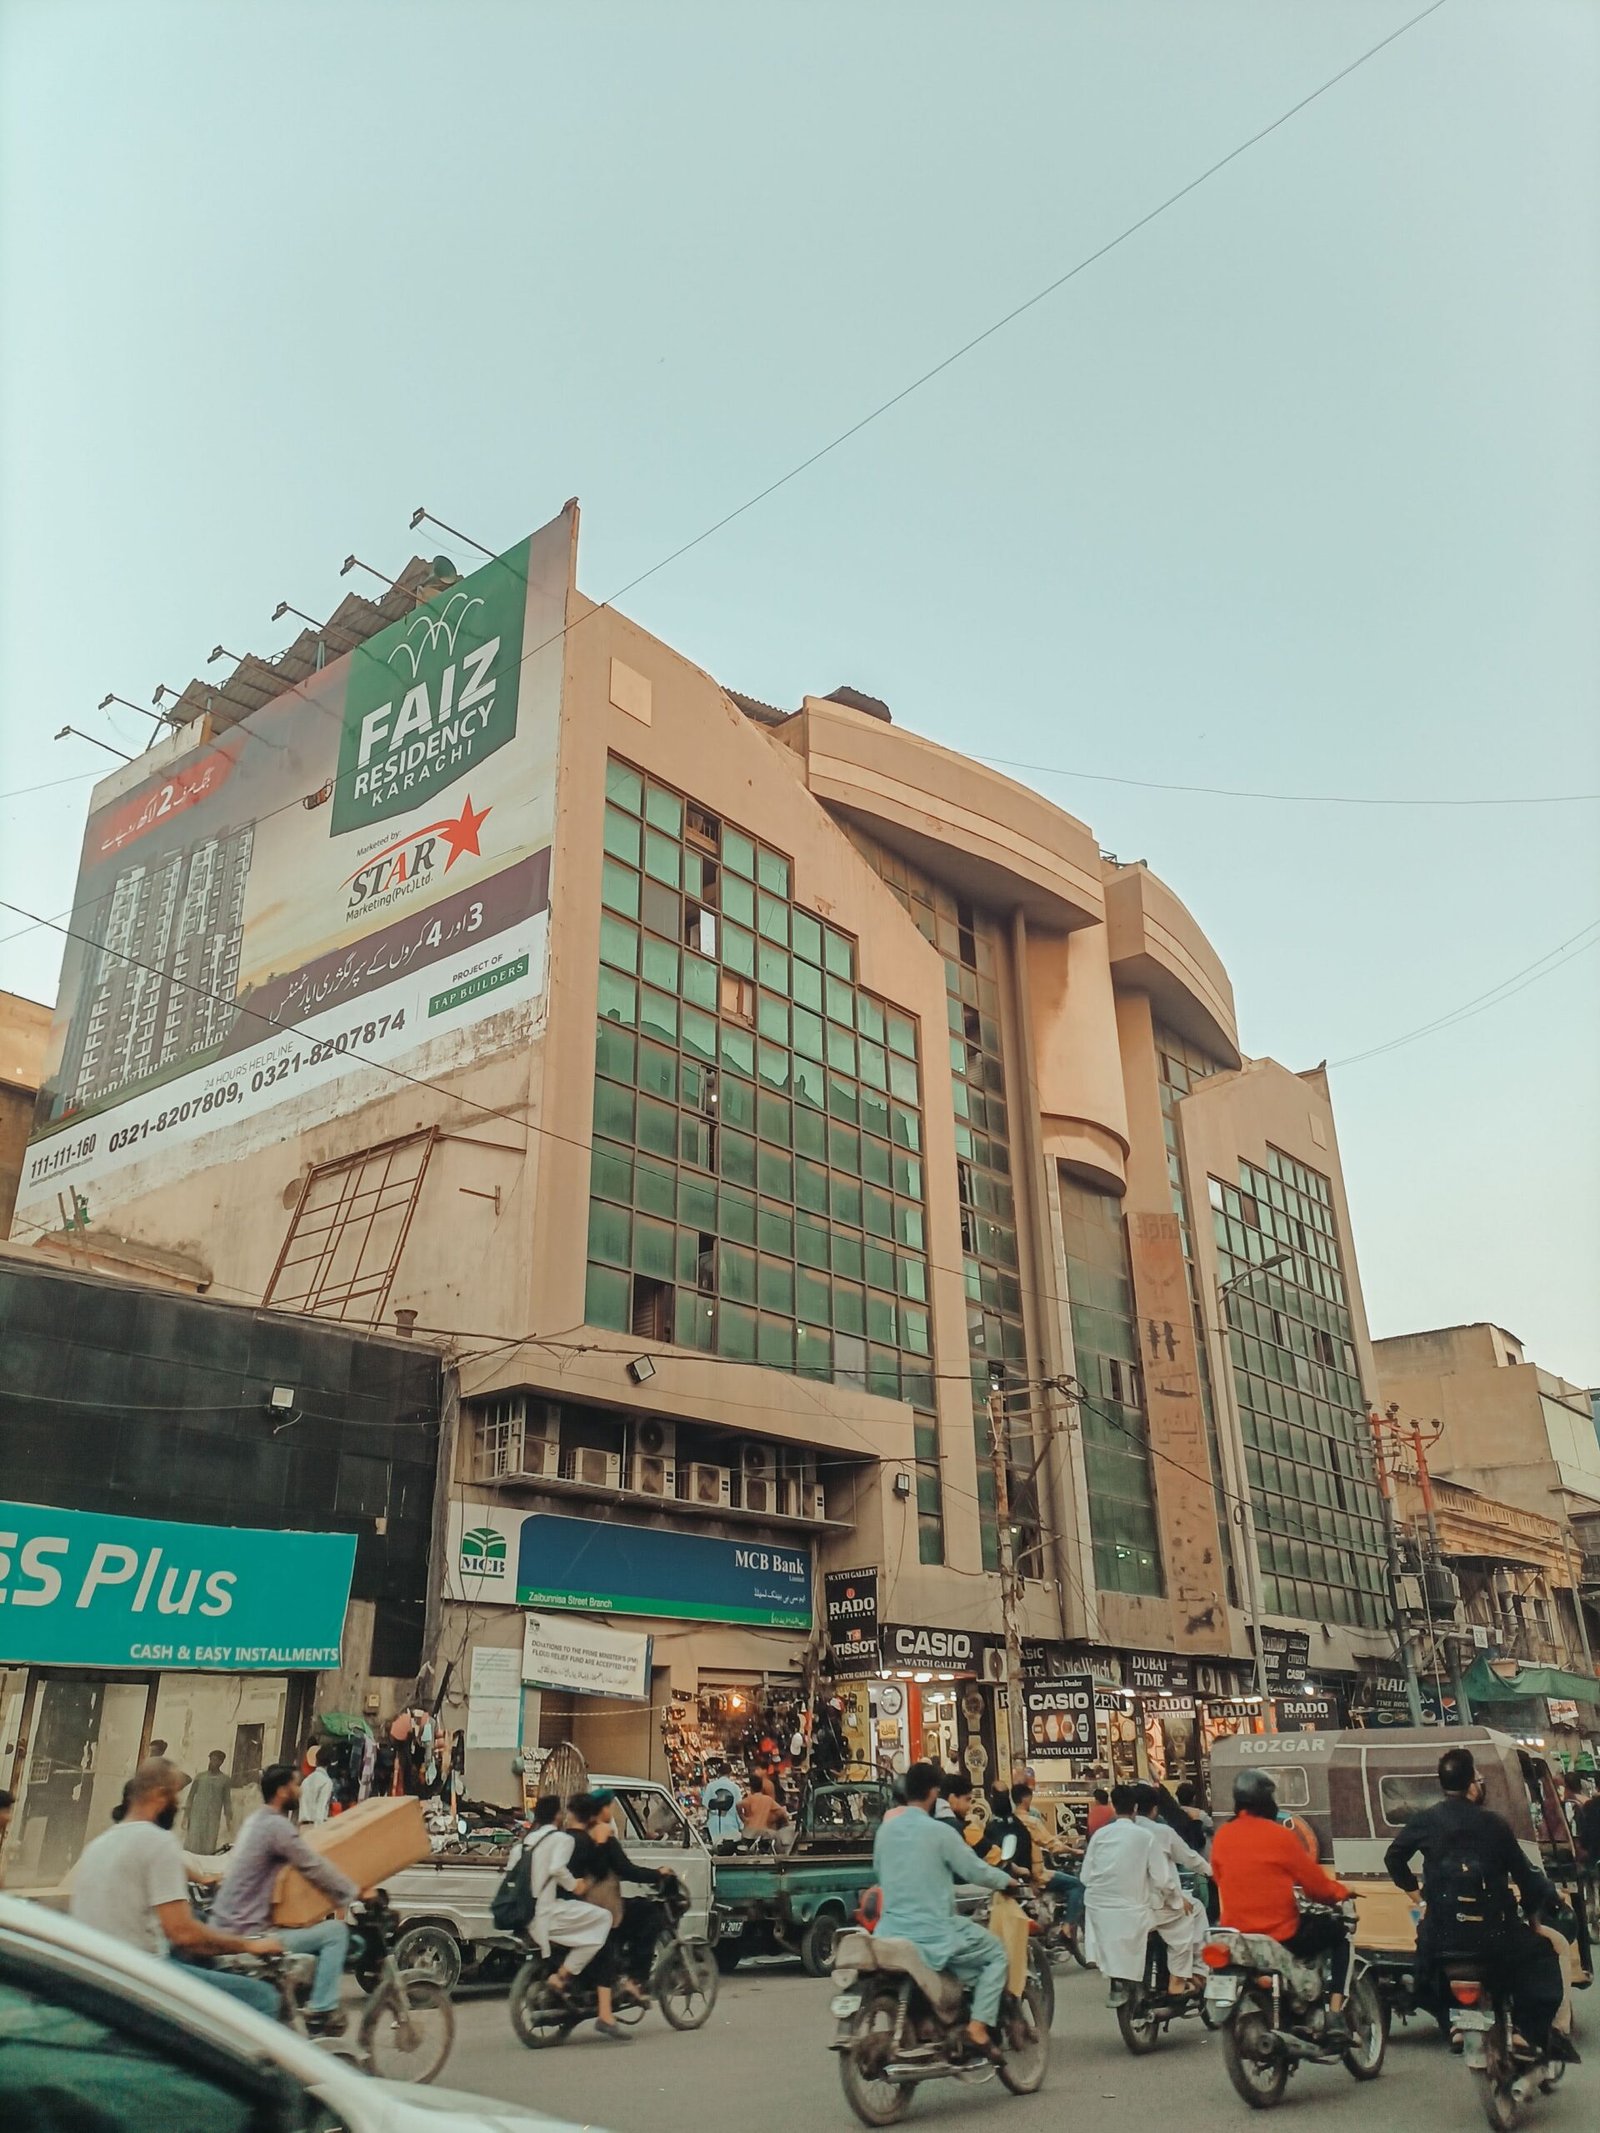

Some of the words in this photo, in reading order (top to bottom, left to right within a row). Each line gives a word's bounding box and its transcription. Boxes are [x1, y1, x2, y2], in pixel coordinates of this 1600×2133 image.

[358, 635, 500, 770] FAIZ
[354, 698, 495, 799] RESIDENCY
[372, 739, 472, 807] KARACHI
[356, 836, 389, 857] Marketed
[347, 837, 436, 908] STAR
[467, 902, 483, 932] 3
[426, 919, 442, 947] 4
[452, 960, 489, 983] PROJECT
[491, 953, 504, 966] OF
[434, 993, 457, 1010] TAP
[460, 962, 524, 999] BUILDERS
[251, 1008, 406, 1092] 0321-8207874
[203, 1077, 215, 1092] 24
[216, 1062, 247, 1084] HOURS
[249, 1041, 294, 1072] HELPLINE
[31, 1133, 97, 1178] 111-111-160
[461, 1556, 505, 1573] MCB
[735, 1550, 769, 1570] MCB
[773, 1555, 804, 1575] Bank
[75, 1543, 237, 1617] Plus
[828, 1571, 850, 1582] WATCH
[850, 1567, 877, 1579] GALLERY
[568, 1595, 588, 1606] Street
[589, 1597, 613, 1608] Branch
[829, 1597, 875, 1616] RADO
[130, 1643, 173, 1660] CASH
[178, 1645, 190, 1660] &
[195, 1646, 231, 1661] EASY
[235, 1647, 339, 1662] INSTALLMENTS
[572, 1647, 582, 1655] THE
[582, 1649, 598, 1657] PRIME
[833, 1640, 877, 1656] TISSOT
[895, 1629, 971, 1659] CASIO
[551, 1652, 569, 1661] RELIEF
[569, 1655, 584, 1664] FUND
[584, 1657, 595, 1666] ARE
[596, 1659, 621, 1670] ACCEPTED
[903, 1658, 933, 1668] WATCH
[934, 1660, 968, 1670] GALLERY
[1132, 1655, 1168, 1672] DUBAI
[834, 1671, 854, 1681] WATCH
[1064, 1679, 1082, 1688] Dealer
[1134, 1671, 1165, 1688] TIME
[1286, 1669, 1306, 1680] CASIO
[1029, 1692, 1090, 1711] CASIO
[1146, 1698, 1192, 1712] RADO
[1211, 1703, 1259, 1718] RADO
[1283, 1702, 1329, 1714] RADO
[1036, 1747, 1061, 1755] WATCH
[1062, 1746, 1093, 1755] GALLERY
[1240, 1738, 1326, 1754] ROZGAR
